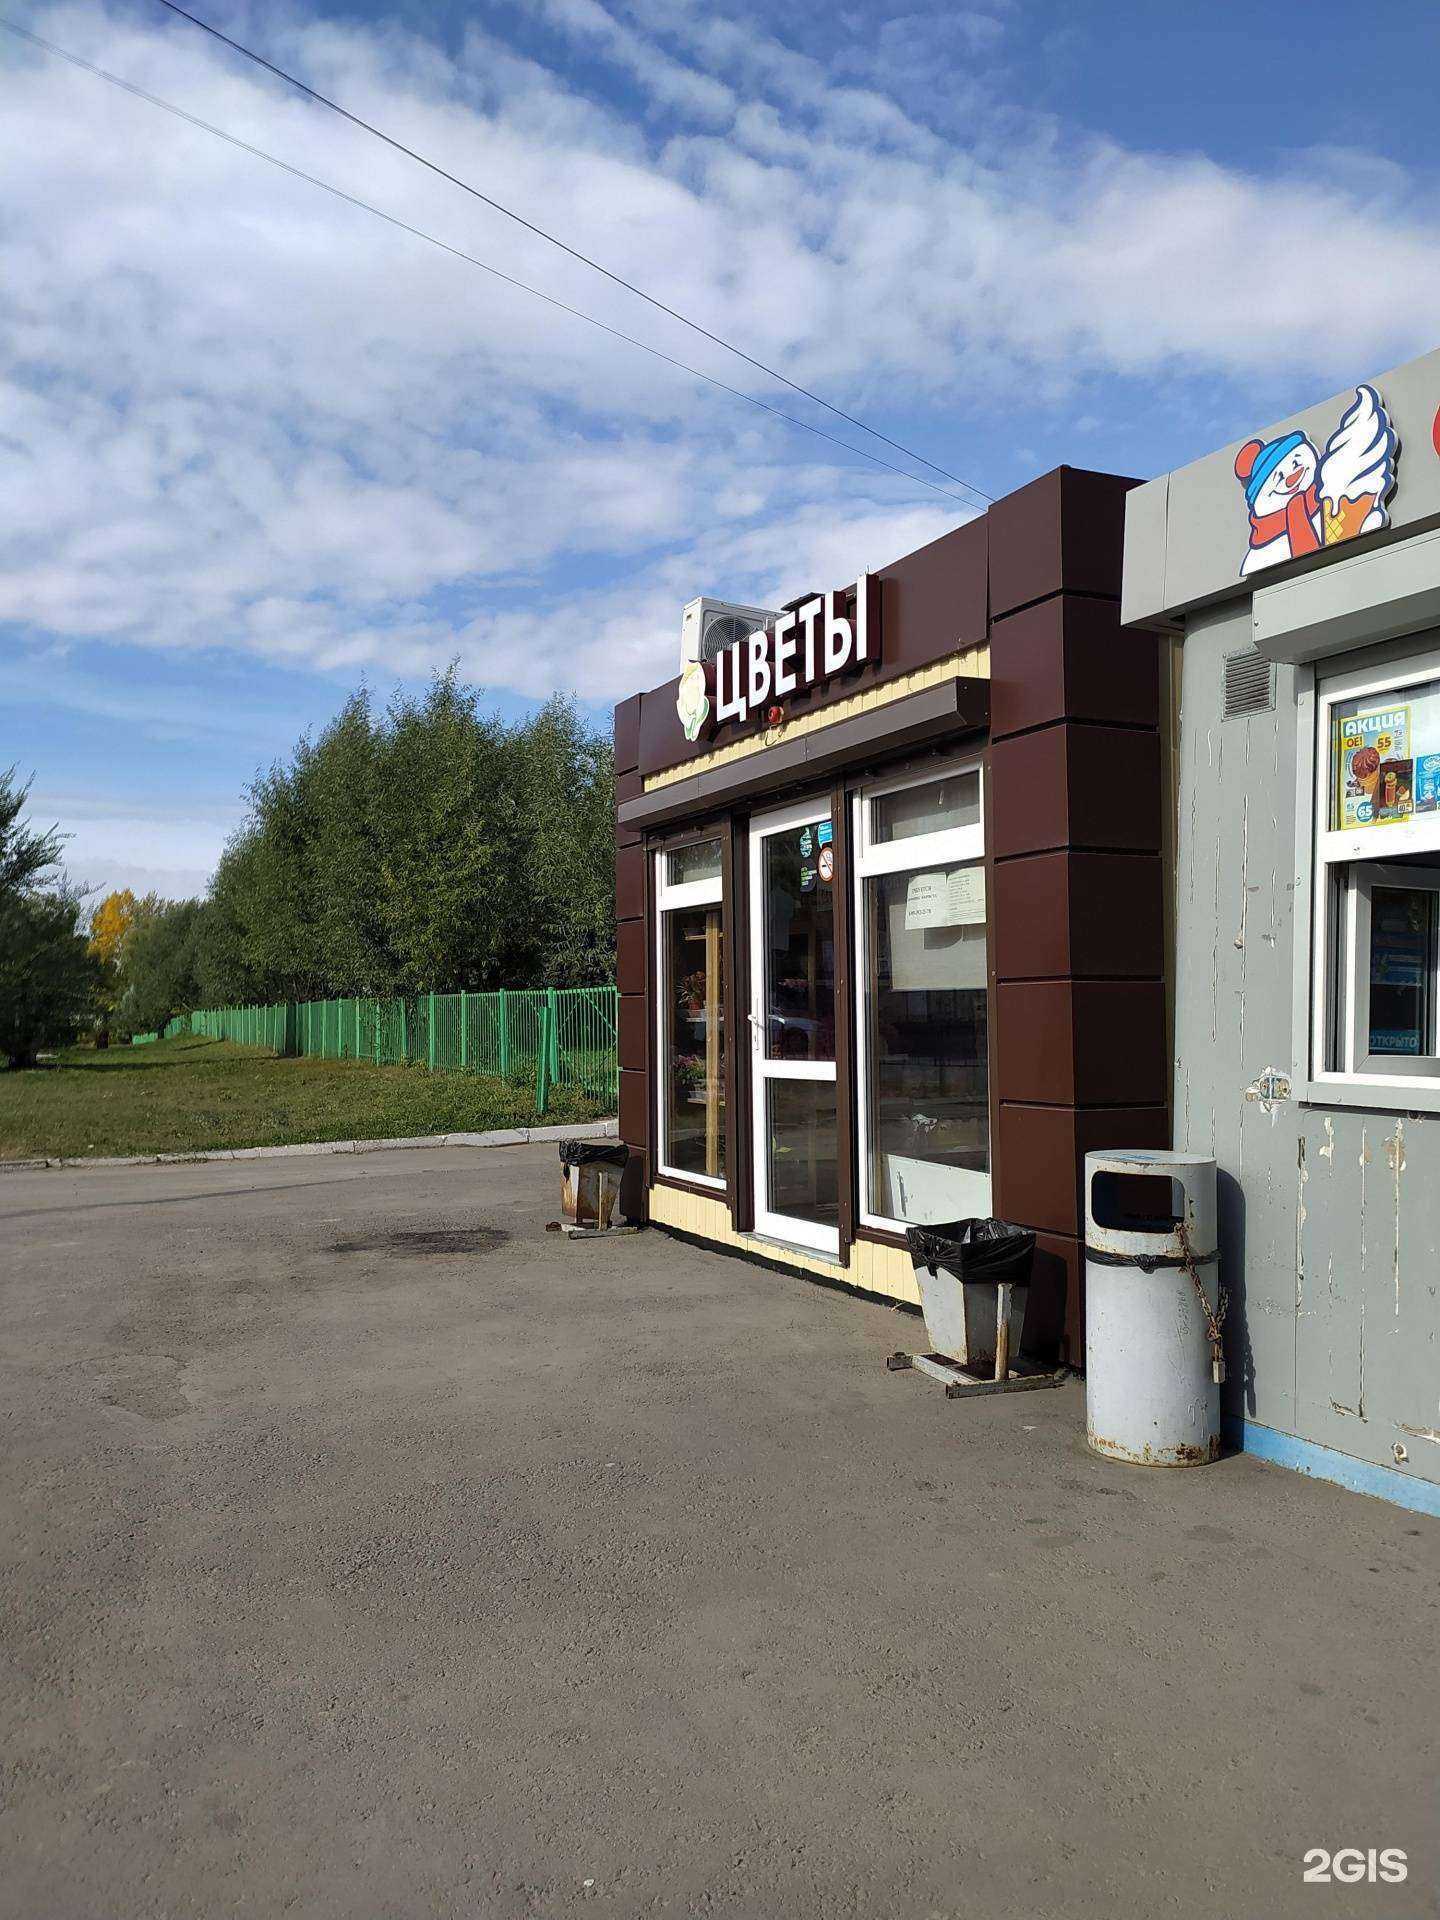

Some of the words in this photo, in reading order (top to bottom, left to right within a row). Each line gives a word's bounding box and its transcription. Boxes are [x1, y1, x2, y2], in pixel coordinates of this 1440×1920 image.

[716, 574, 868, 723] ЦВЕТЫ
[1345, 711, 1405, 736] АКЦИЯ
[1377, 735, 1392, 749] 55
